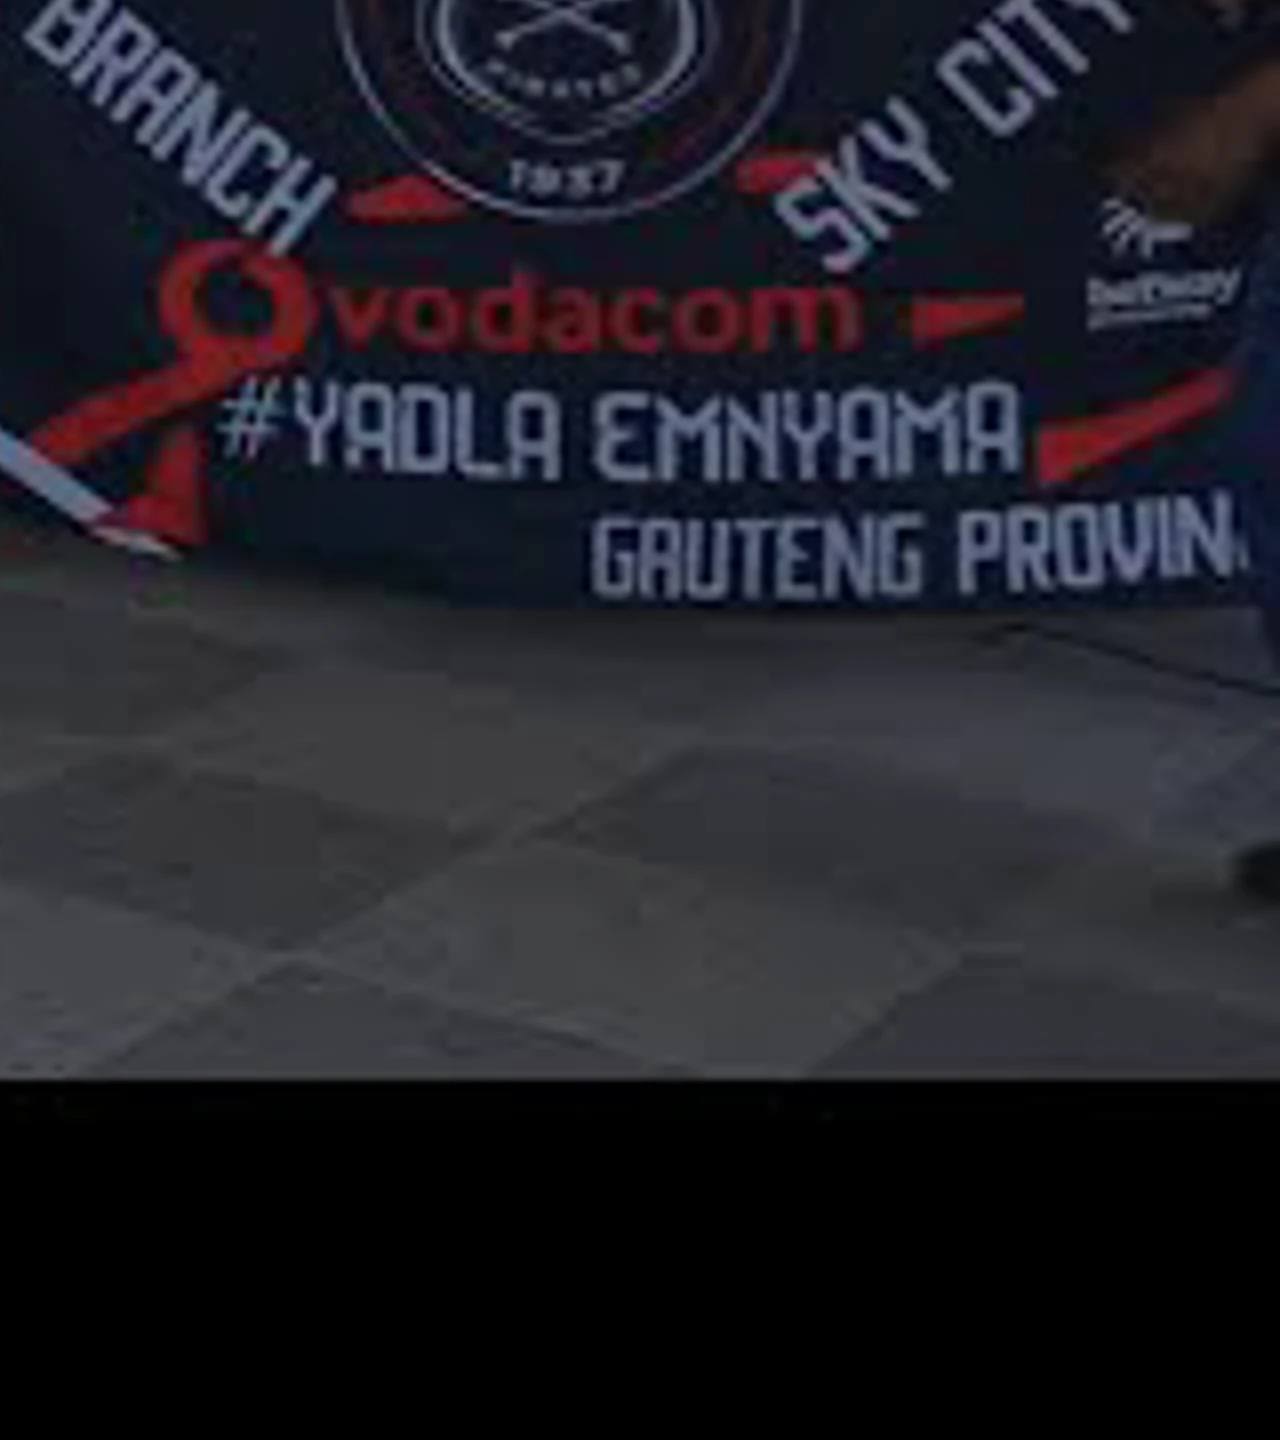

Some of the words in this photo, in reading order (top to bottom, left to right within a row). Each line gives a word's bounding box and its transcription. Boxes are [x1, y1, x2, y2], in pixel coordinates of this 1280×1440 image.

[768, 92, 956, 276] SKY
[322, 270, 866, 354] vodacom
[590, 378, 1024, 484] EMNYAMA
[588, 510, 928, 602] GAUTENG
